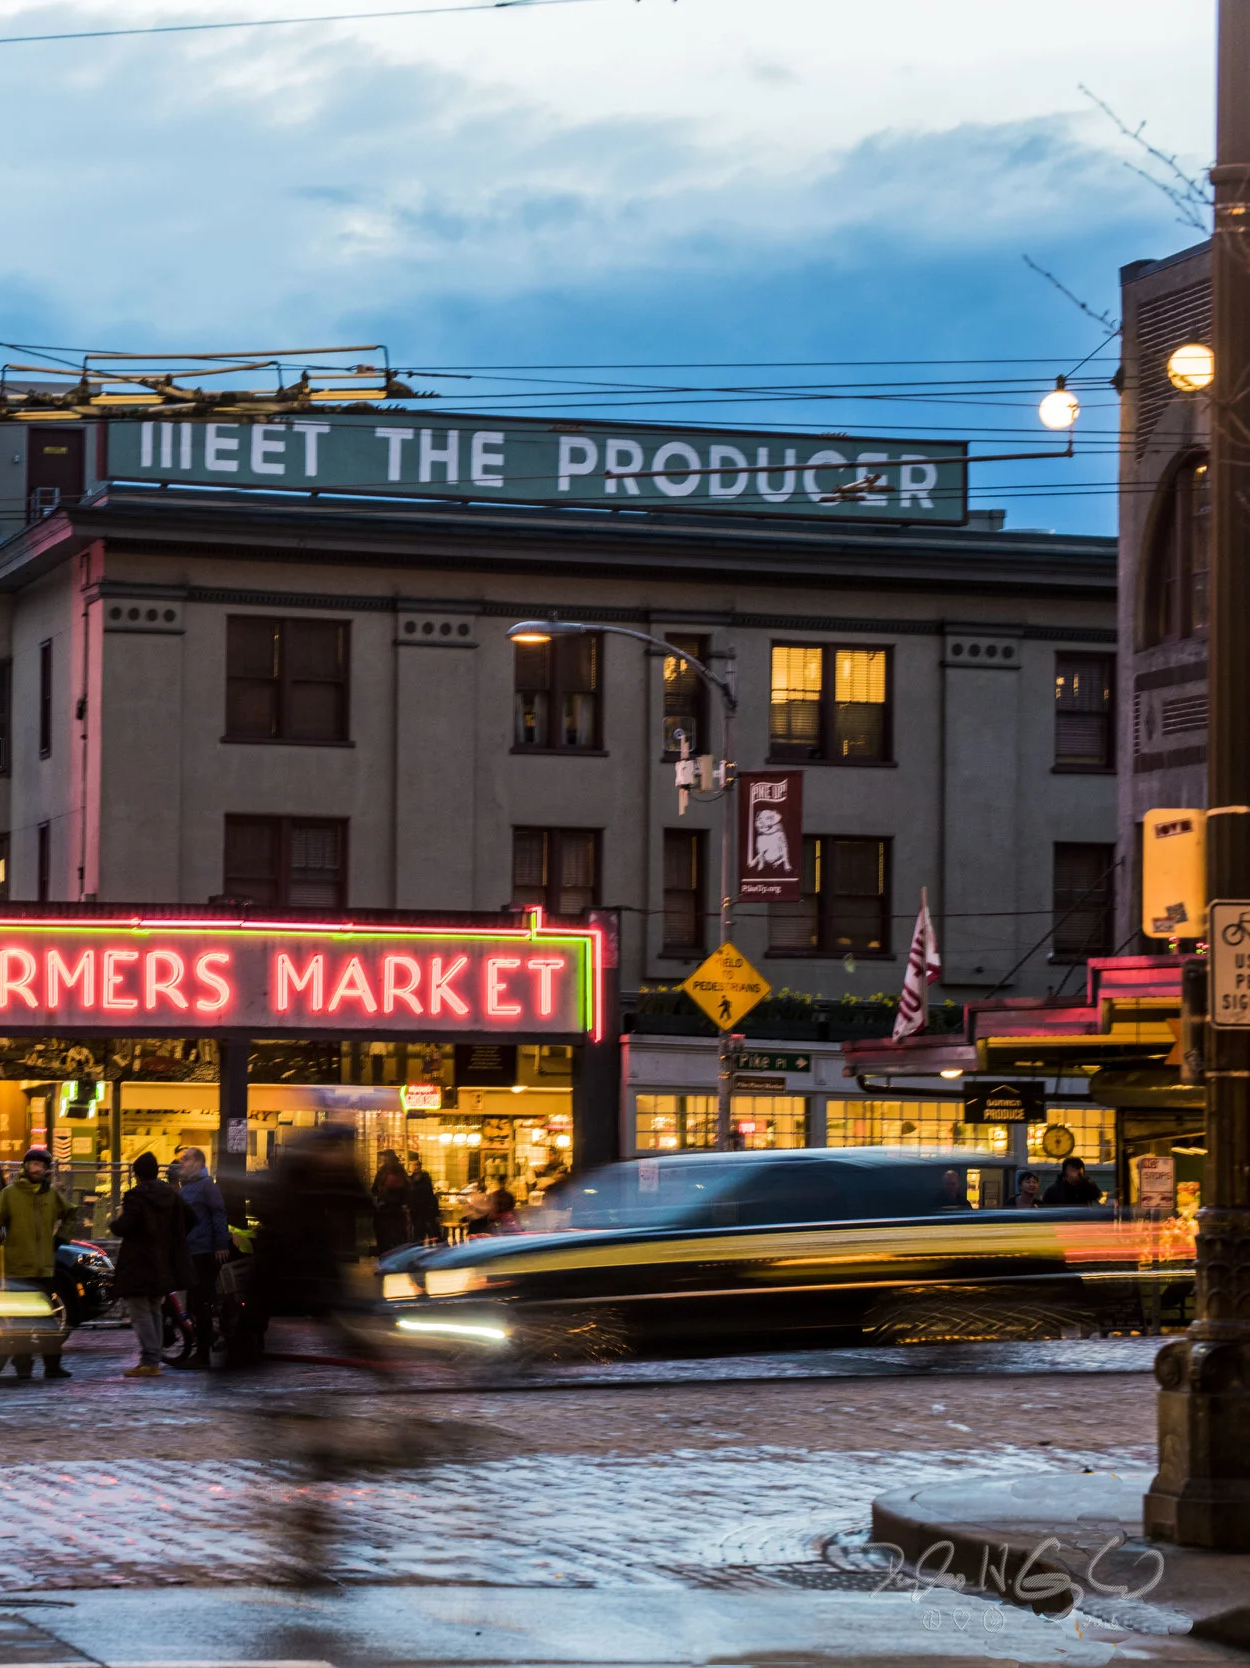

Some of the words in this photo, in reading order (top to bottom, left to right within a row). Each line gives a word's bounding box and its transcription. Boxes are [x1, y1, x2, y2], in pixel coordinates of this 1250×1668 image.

[141, 421, 330, 477] MEET
[375, 426, 505, 488] THE
[558, 436, 938, 508] PRODUCER
[275, 953, 565, 1016] MARKET
[739, 1052, 770, 1068] Pike
[983, 1108, 1026, 1120] PRODUCE
